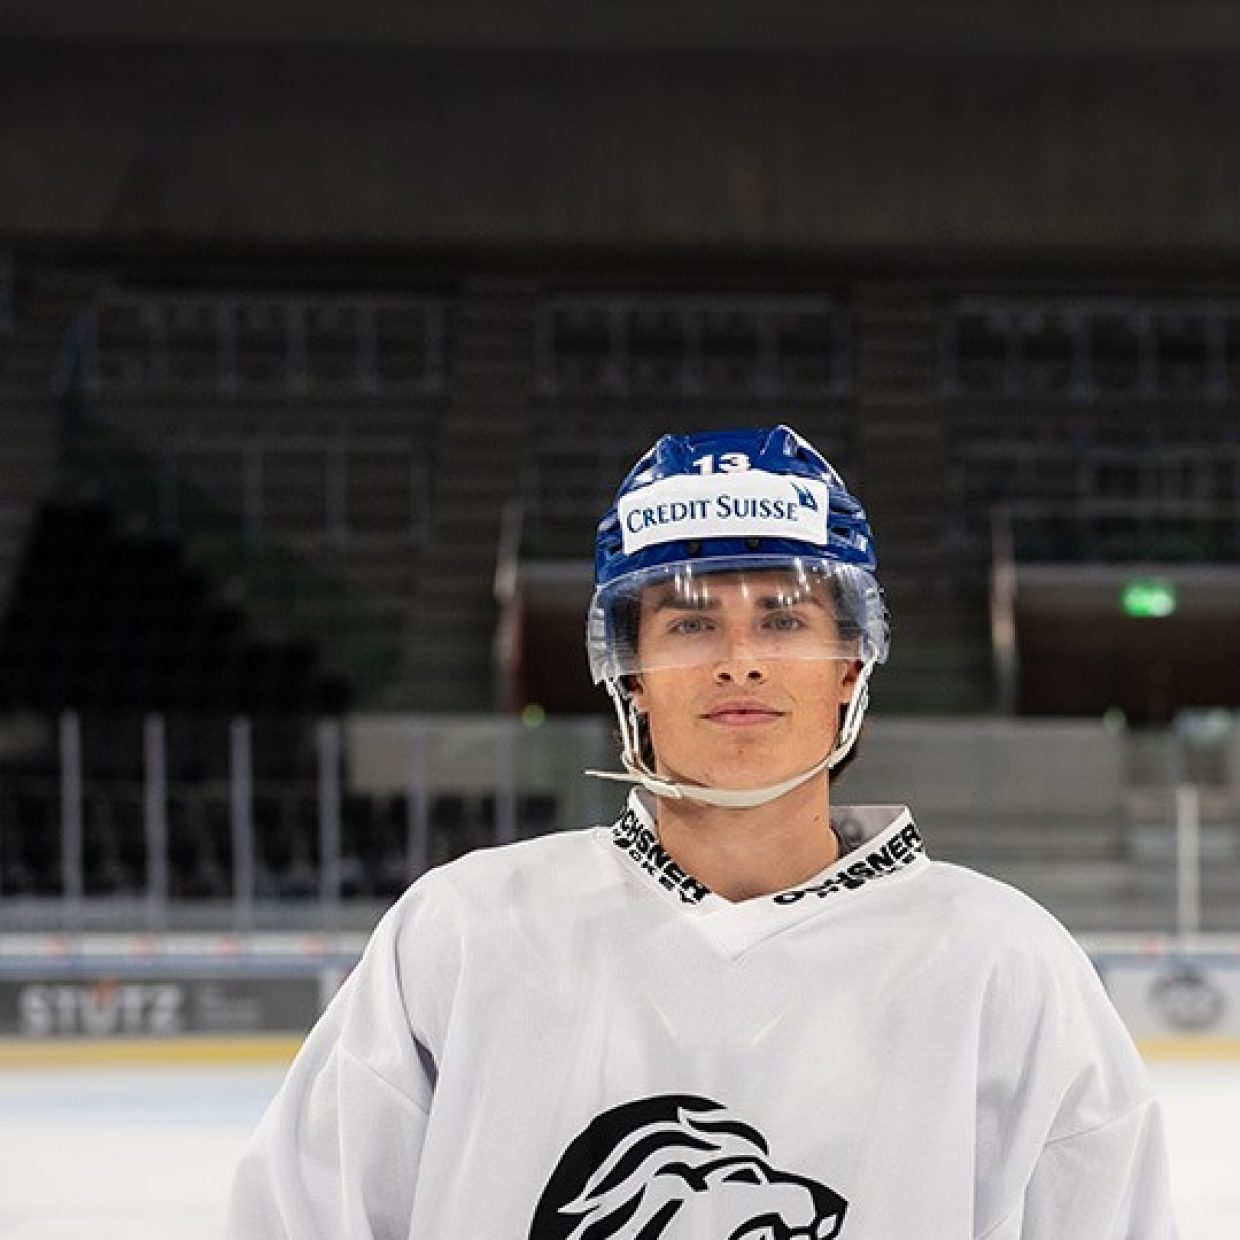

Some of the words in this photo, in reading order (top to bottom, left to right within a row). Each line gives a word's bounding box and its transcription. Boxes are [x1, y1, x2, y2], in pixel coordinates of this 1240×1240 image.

[693, 453, 752, 475] 13
[626, 499, 712, 535] CREDIT
[716, 494, 799, 523] SUISSE
